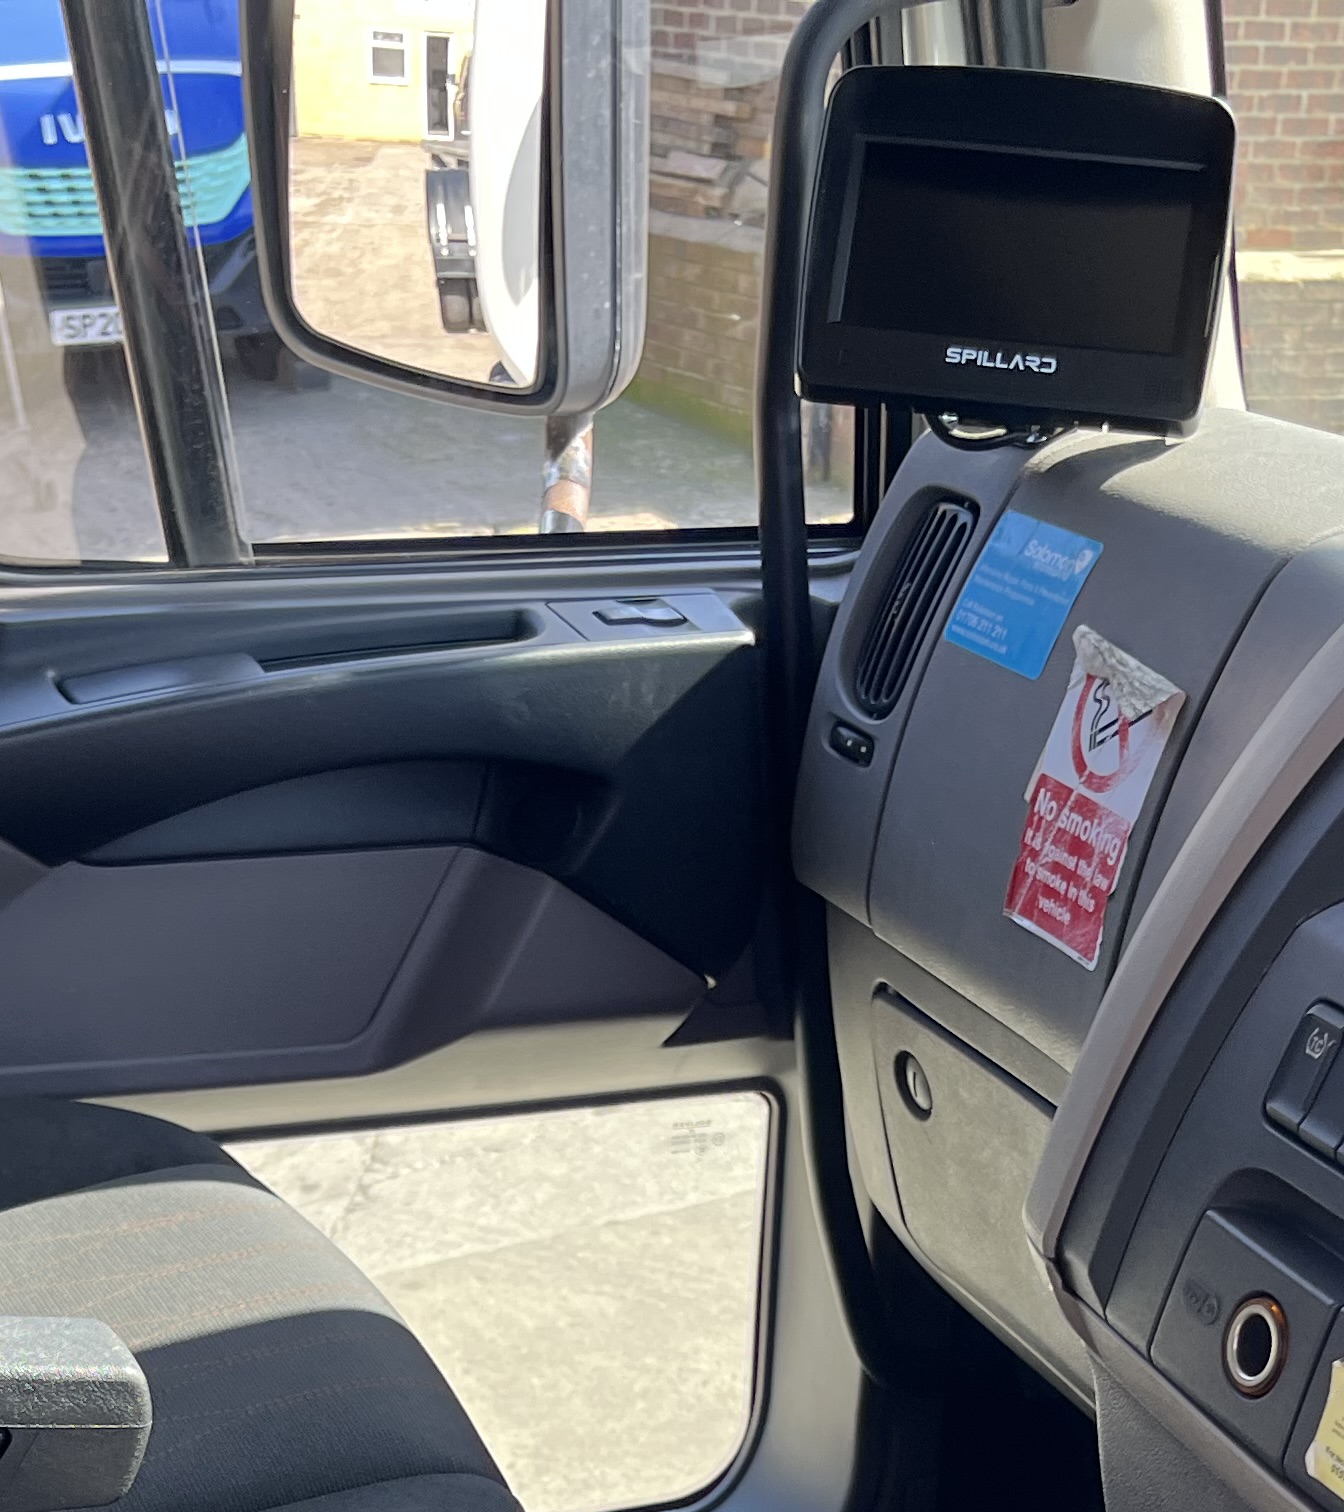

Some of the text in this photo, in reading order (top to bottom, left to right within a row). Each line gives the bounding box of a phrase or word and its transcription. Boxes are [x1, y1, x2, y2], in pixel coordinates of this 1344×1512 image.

[945, 347, 1057, 374] SPILLARD
[1034, 787, 1121, 866] No smoking
